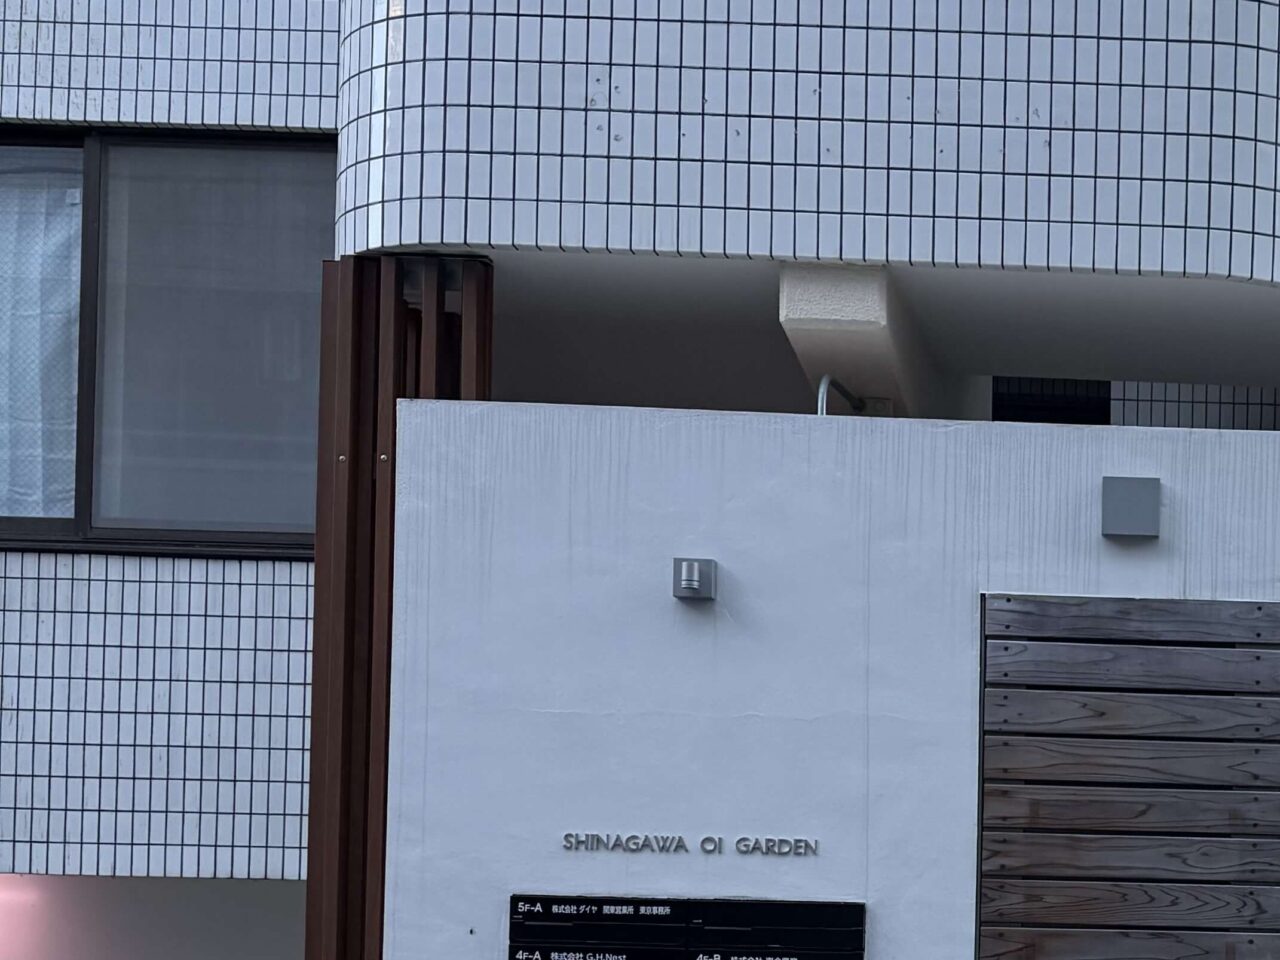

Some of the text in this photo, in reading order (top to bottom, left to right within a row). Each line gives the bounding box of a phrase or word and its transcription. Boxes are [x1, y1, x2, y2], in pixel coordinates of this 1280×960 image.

[563, 833, 819, 856] SHINAGAWA OI GARDEN
[517, 902, 543, 913] 5F-A
[515, 950, 541, 960] 4F-A
